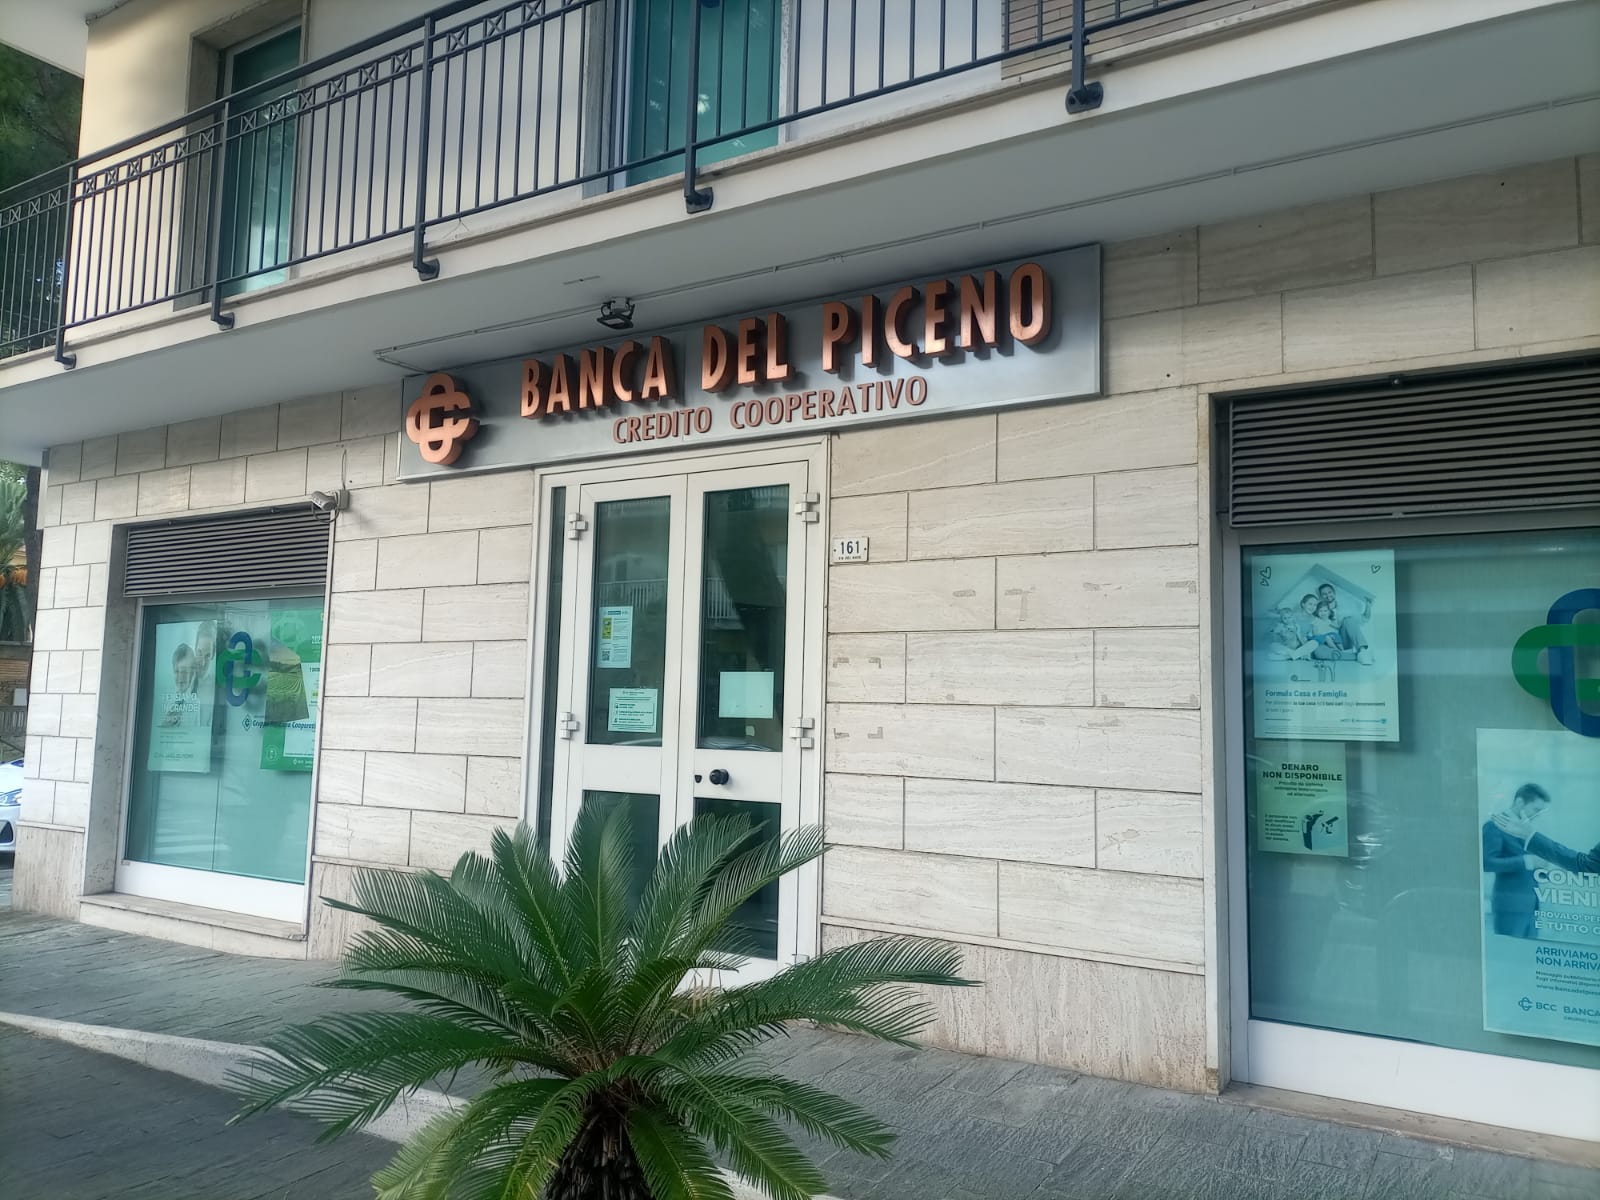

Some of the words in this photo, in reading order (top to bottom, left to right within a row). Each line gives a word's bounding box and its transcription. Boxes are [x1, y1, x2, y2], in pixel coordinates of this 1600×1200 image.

[521, 336, 671, 419] BANCA
[701, 312, 793, 394] DEL
[822, 262, 1049, 374] PICENO
[612, 405, 712, 444] CREDITO
[730, 375, 928, 430] COOPERATIVO
[840, 540, 861, 555] 161
[1265, 689, 1292, 697] Formula
[1318, 690, 1347, 698] Famiglia
[1281, 763, 1319, 771] DENARO
[1285, 772, 1343, 781] DISPONIBILE
[1533, 868, 1600, 888] CONT
[1546, 921, 1589, 934] TUTTO
[1535, 946, 1598, 960] ARRIVIAMO
[1535, 956, 1561, 967] NON
[1535, 1002, 1557, 1011] BCC
